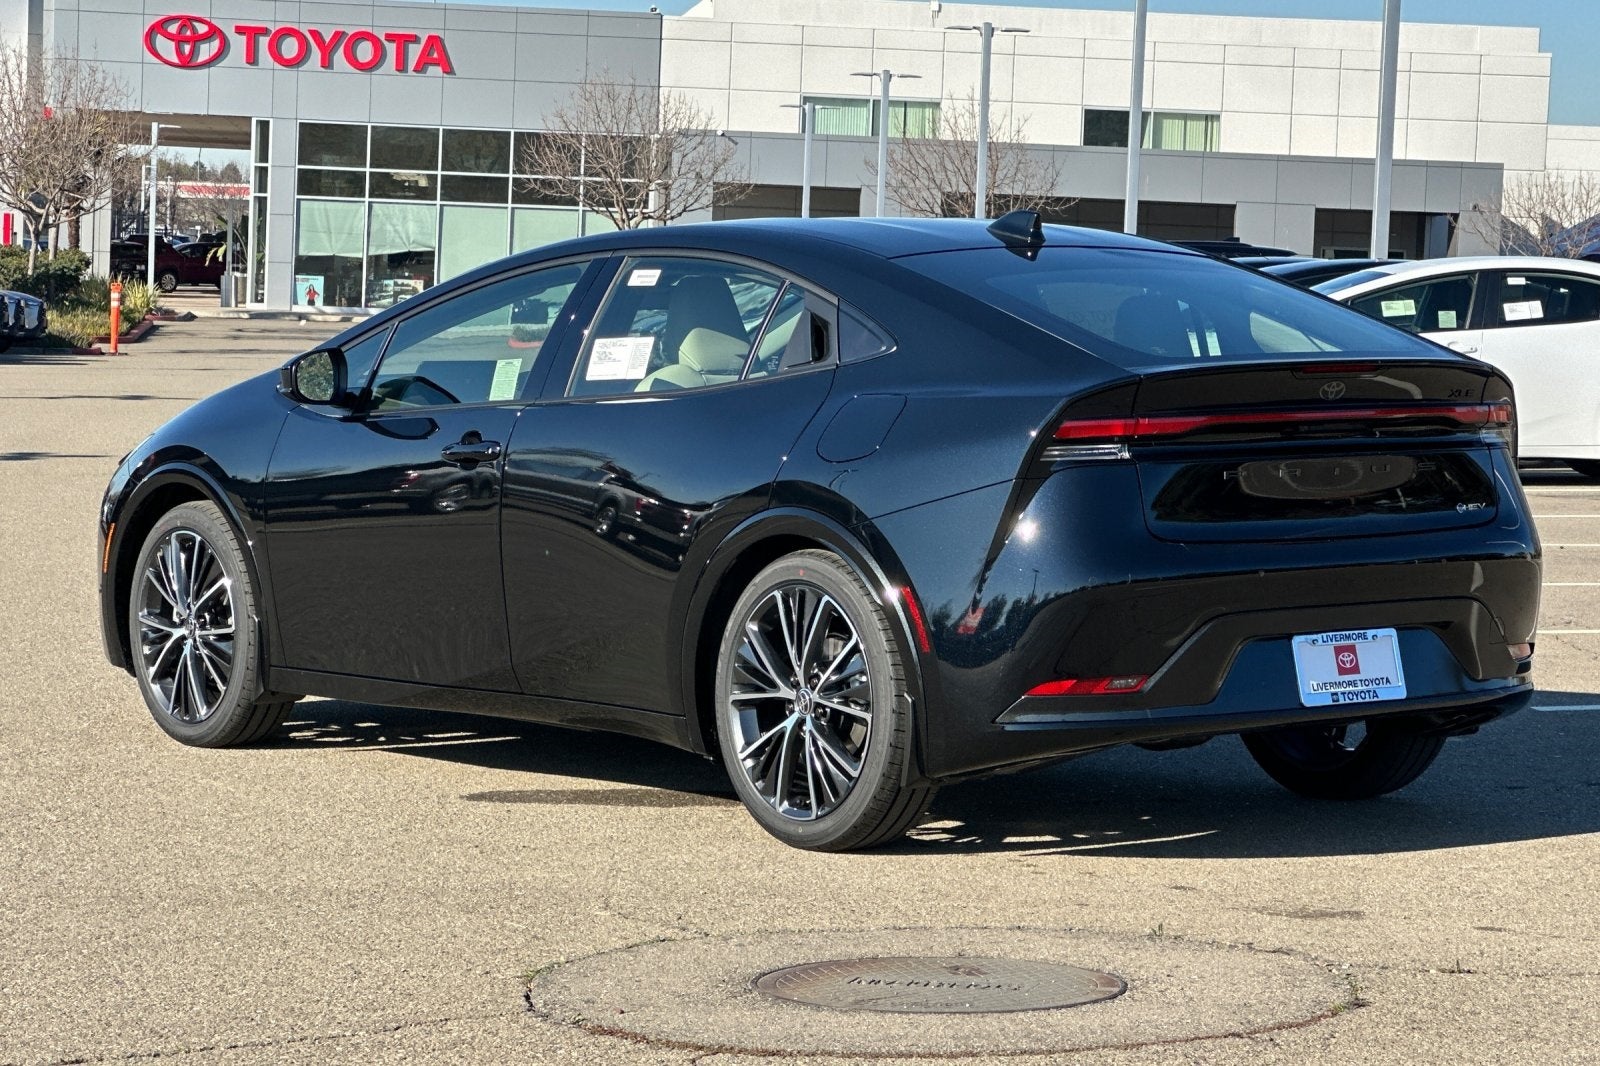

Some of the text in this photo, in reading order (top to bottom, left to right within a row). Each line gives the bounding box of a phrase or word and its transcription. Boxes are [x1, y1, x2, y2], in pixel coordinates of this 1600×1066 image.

[234, 25, 453, 74] TOYOTA
[1321, 631, 1369, 644] LIVERMORE
[1311, 676, 1392, 692] LIVERMORE TOYOTA
[1341, 689, 1380, 702] TOYOTA
